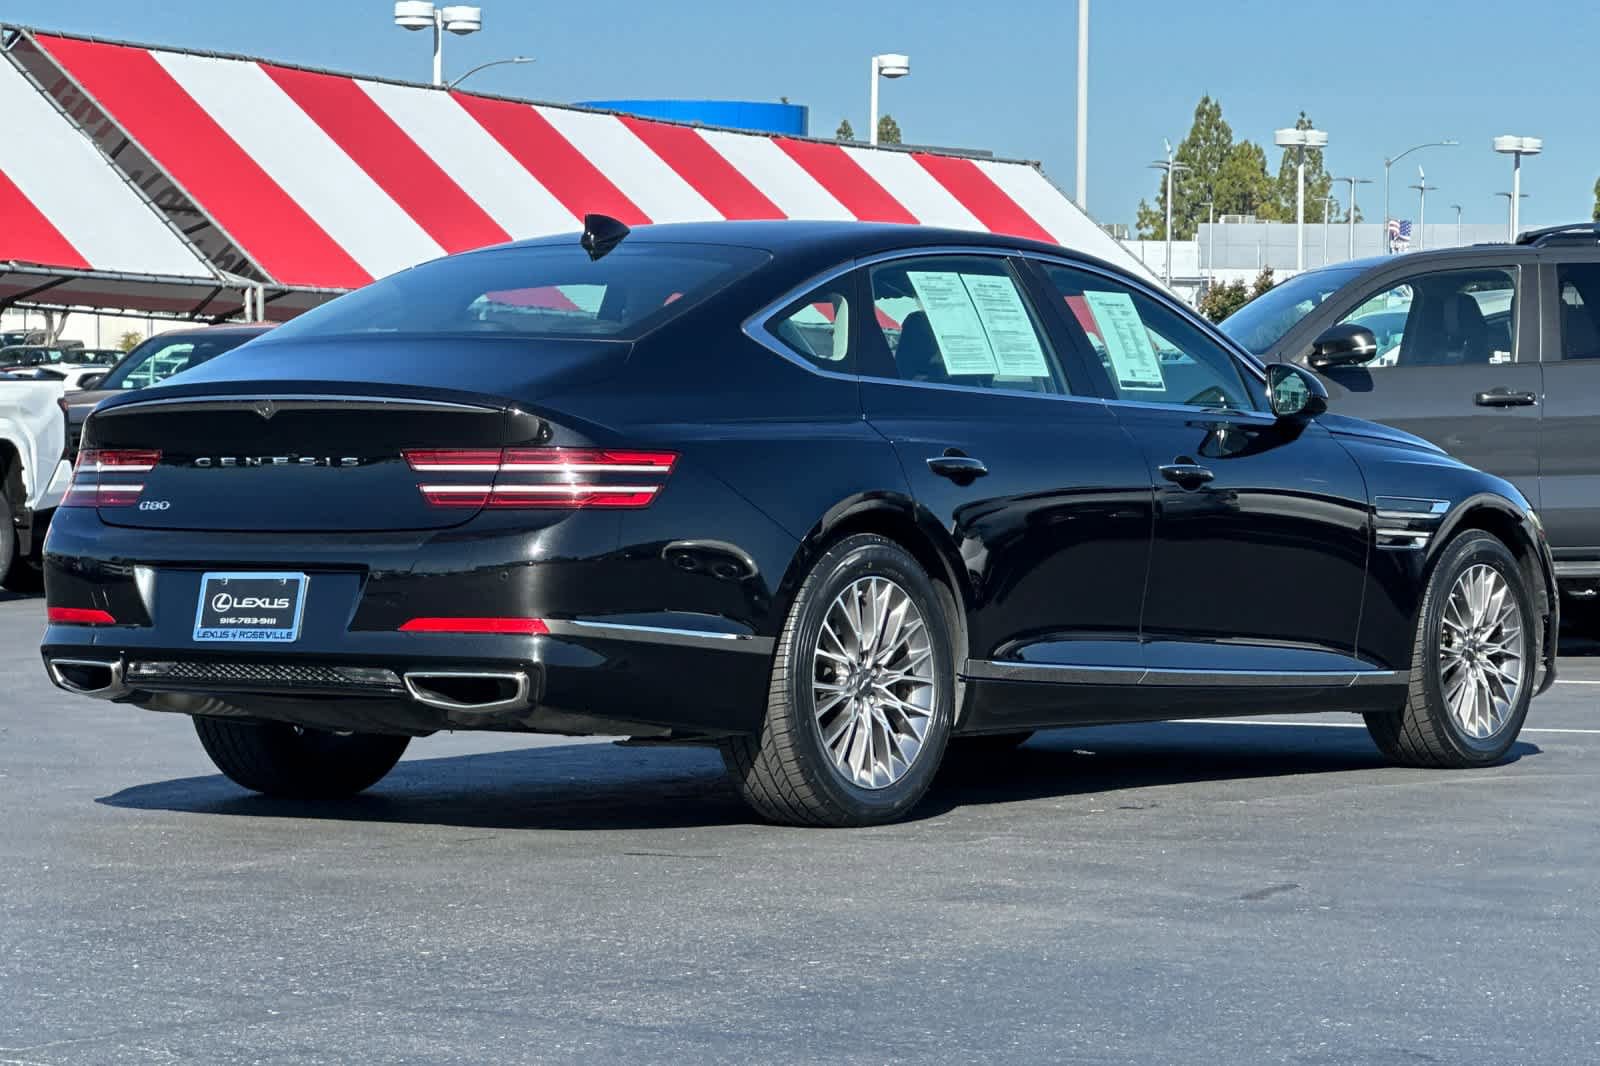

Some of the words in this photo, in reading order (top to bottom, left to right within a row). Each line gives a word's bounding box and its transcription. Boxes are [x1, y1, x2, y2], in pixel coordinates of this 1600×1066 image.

[194, 457, 360, 467] GENESIS
[138, 500, 171, 511] G80
[233, 597, 290, 609] LEXUS
[219, 617, 277, 625] 916-783-9111
[197, 630, 229, 639] LEXUS
[238, 631, 293, 640] ROSEVILLE
